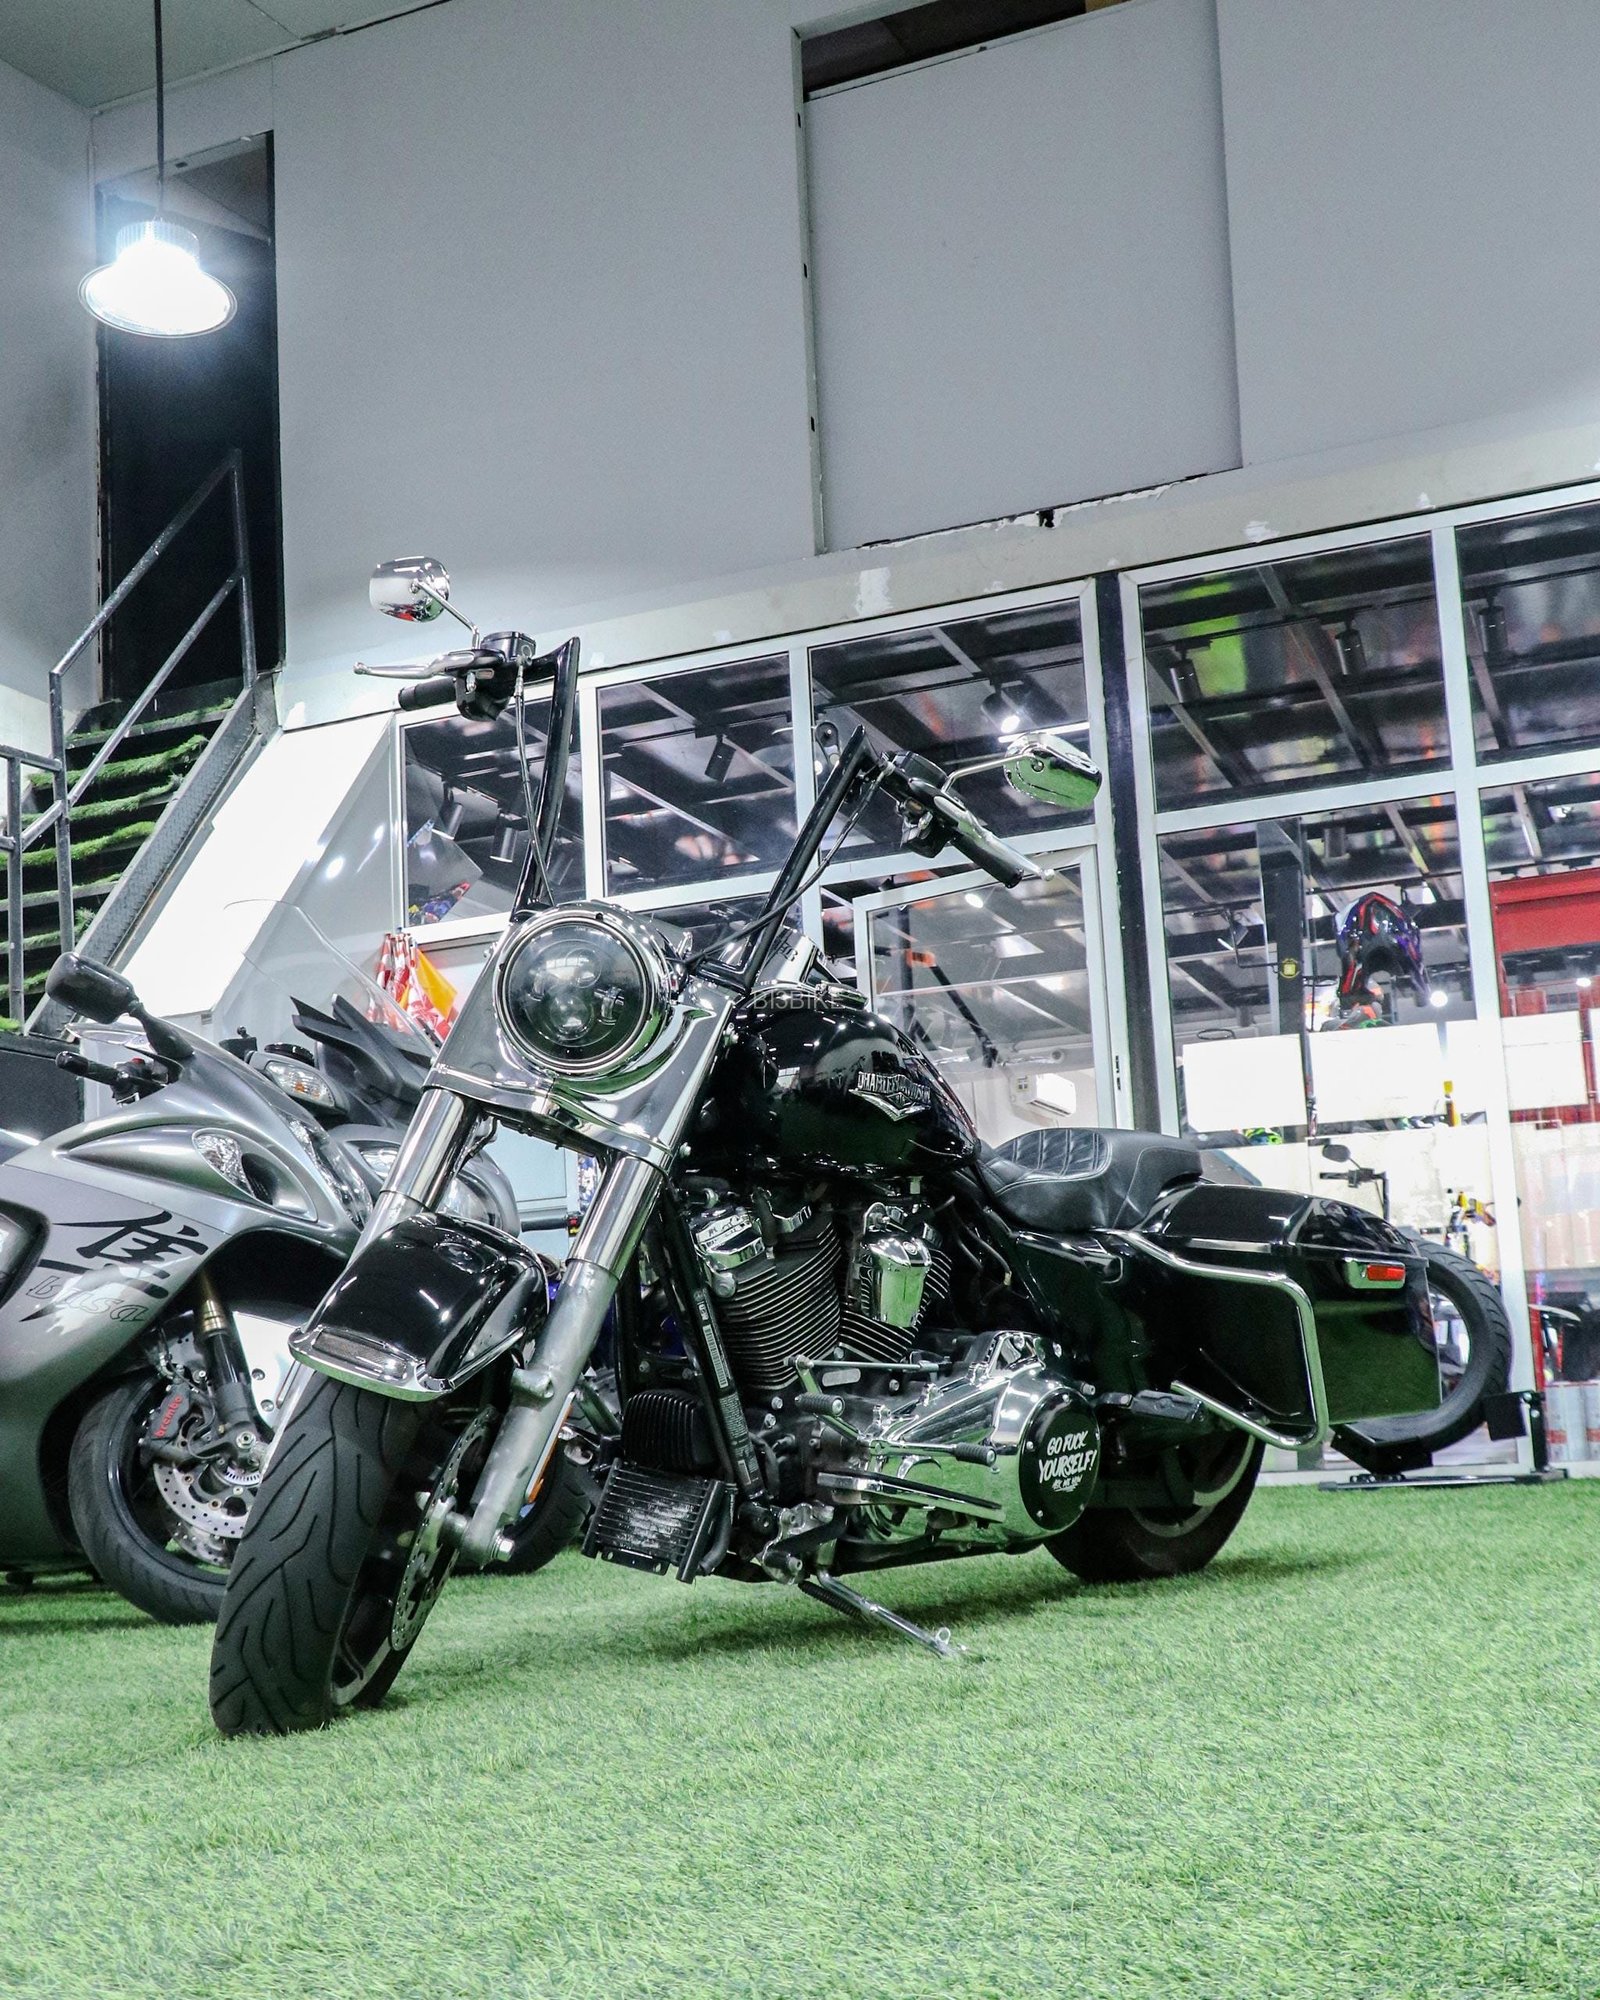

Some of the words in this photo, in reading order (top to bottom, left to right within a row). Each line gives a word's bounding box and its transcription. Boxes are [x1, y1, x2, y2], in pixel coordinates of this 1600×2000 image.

[153, 1394, 183, 1438] brembo
[1047, 1437, 1062, 1456] GO
[1063, 1430, 1088, 1452] FUCK
[1039, 1449, 1097, 1483] YOURSELF!
